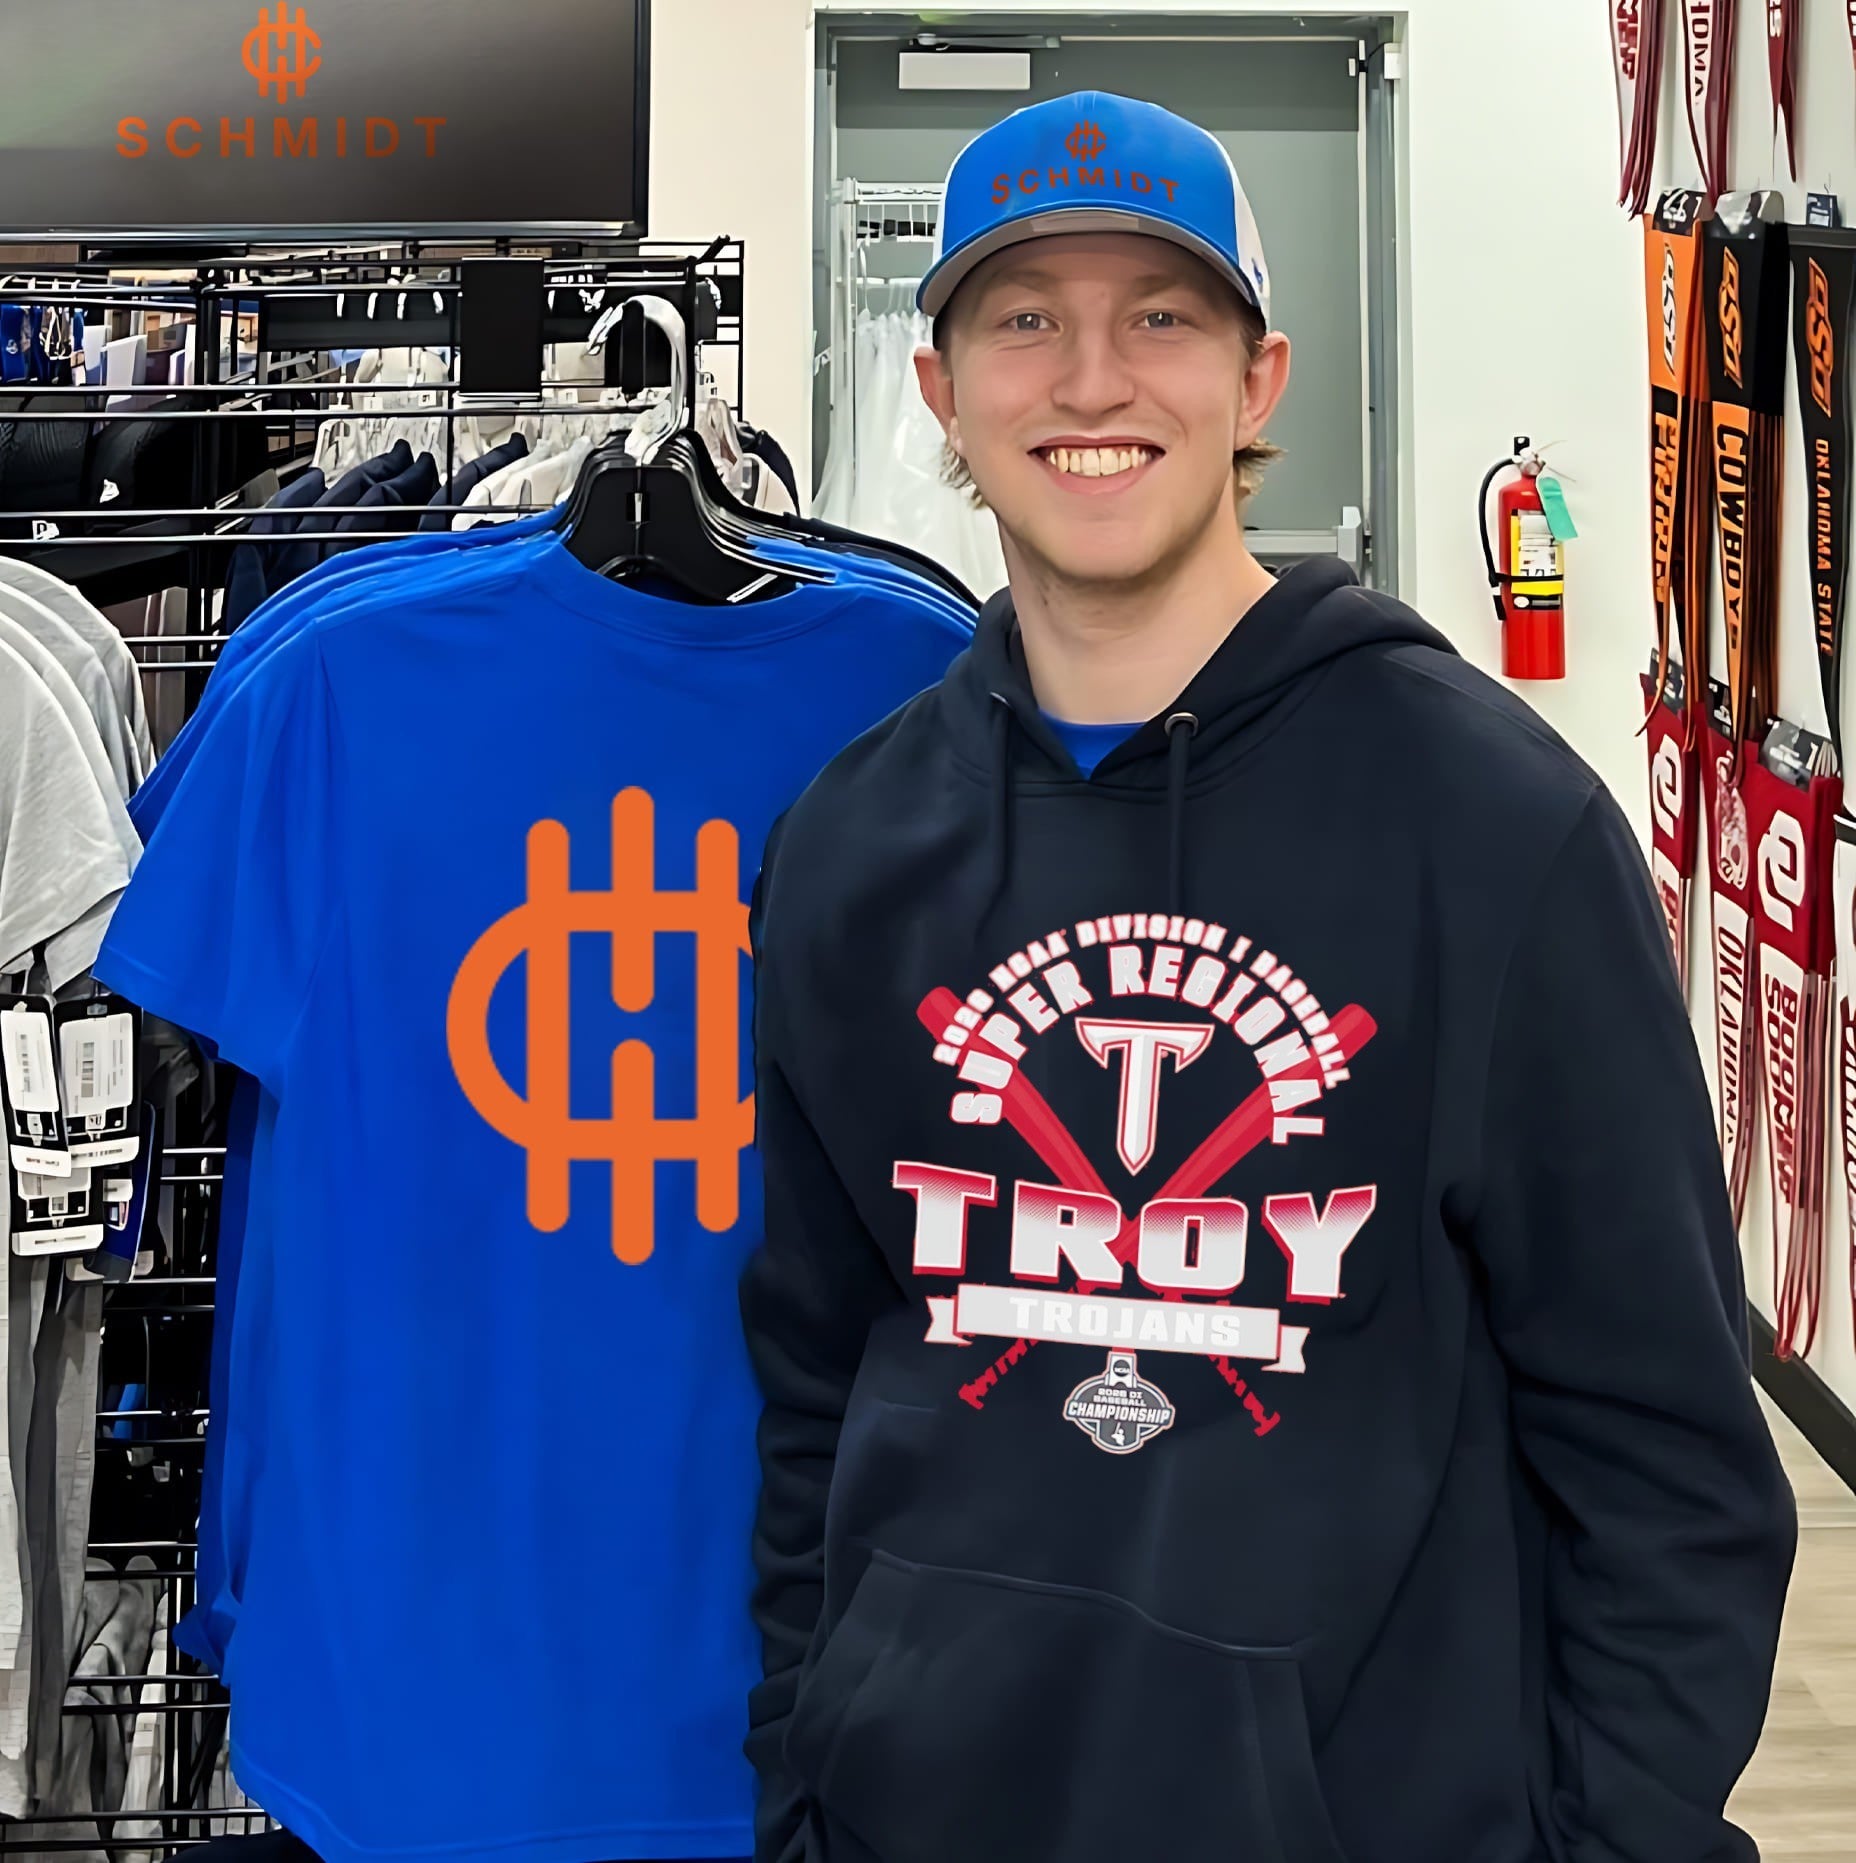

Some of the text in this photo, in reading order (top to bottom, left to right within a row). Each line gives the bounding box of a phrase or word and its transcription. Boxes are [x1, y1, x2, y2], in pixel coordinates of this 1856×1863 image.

[116, 117, 448, 159] SCHMIDT
[991, 167, 1180, 205] SCHMIDT
[1805, 257, 1834, 418] OSU
[1815, 438, 1833, 571] OKLAHOMA
[950, 944, 1325, 1145] SUPER REGIONAL
[988, 930, 1071, 993] NCAA
[1075, 912, 1228, 952] DIVISION
[1249, 950, 1350, 1090] BASEBALL
[1718, 926, 1746, 1144] OKLAHOMA
[892, 1160, 1378, 1305] TROY
[1009, 1296, 1241, 1348] TROJANS
[1068, 1401, 1171, 1423] CHAMPIONSHIP
[1093, 1395, 1147, 1407] BASEBALL
